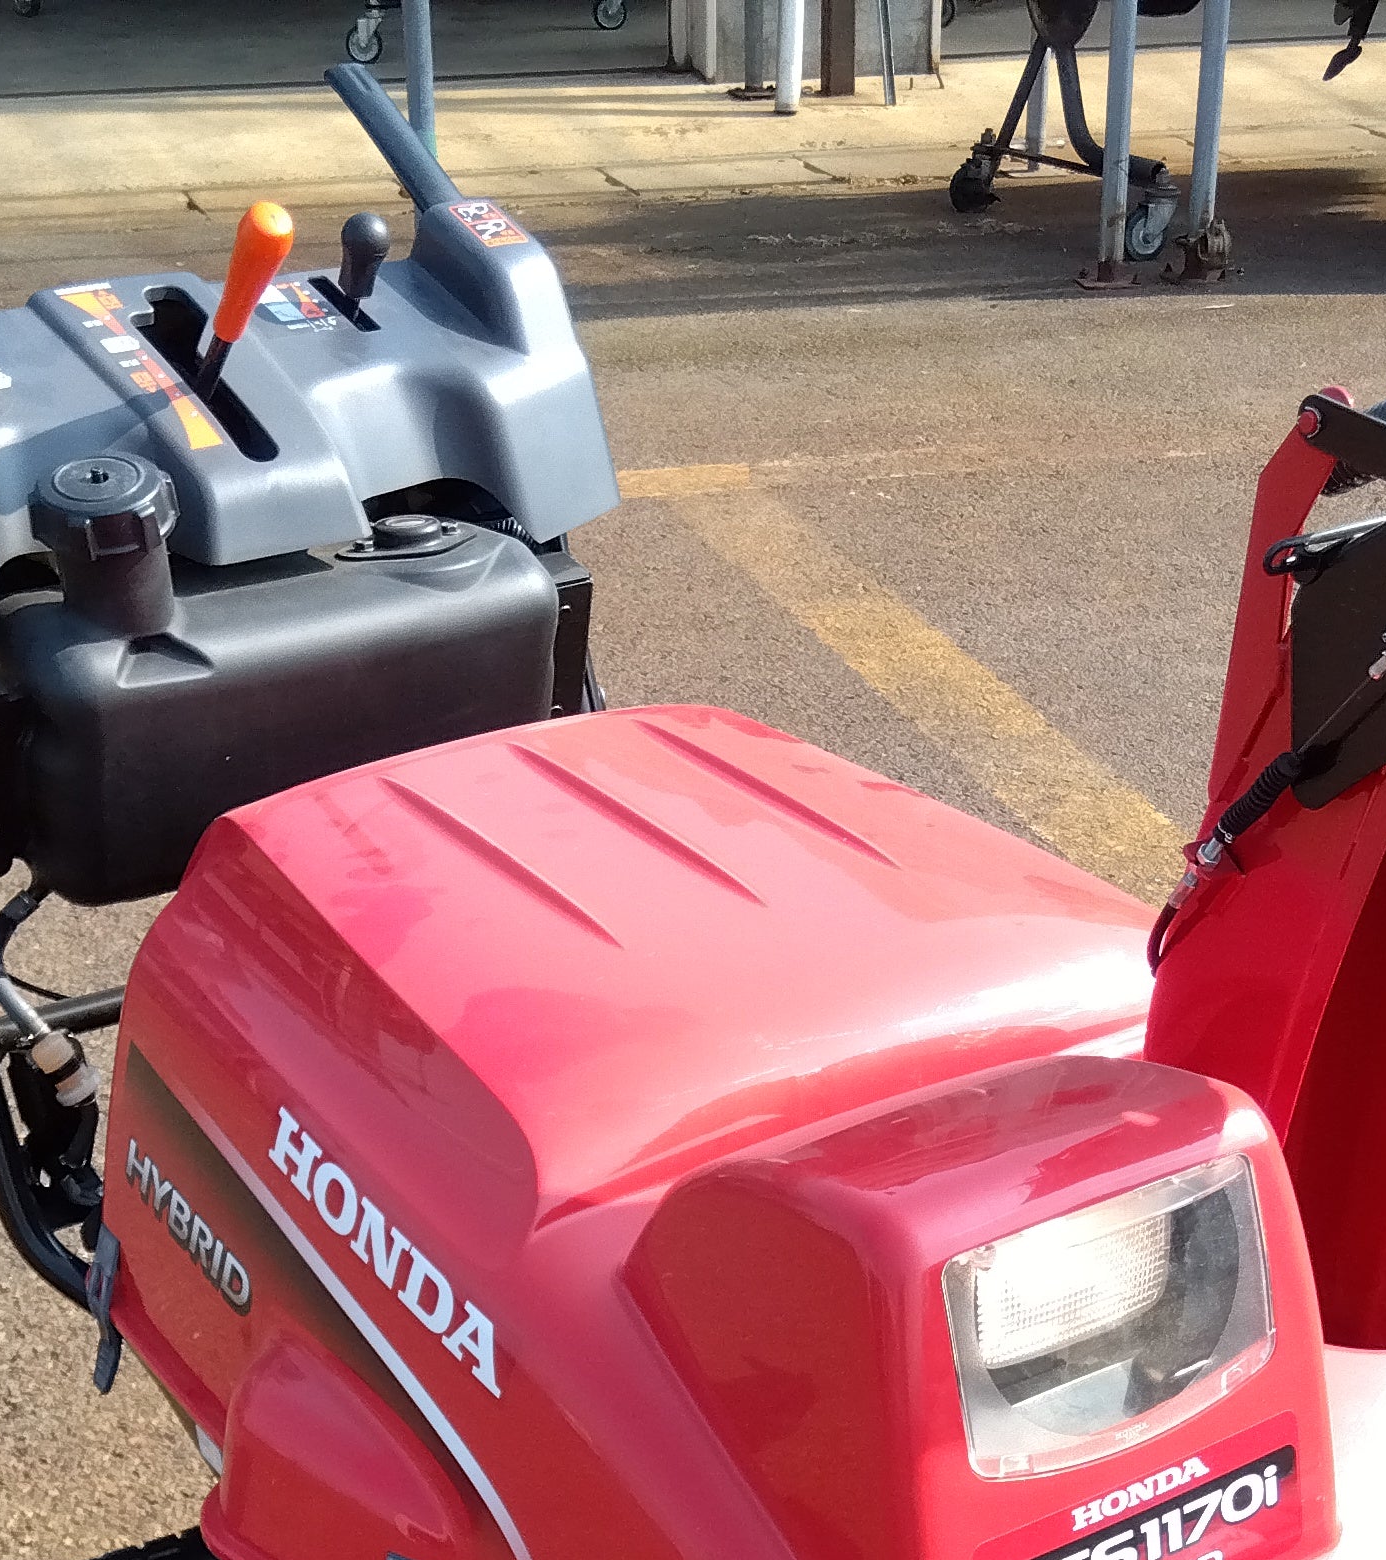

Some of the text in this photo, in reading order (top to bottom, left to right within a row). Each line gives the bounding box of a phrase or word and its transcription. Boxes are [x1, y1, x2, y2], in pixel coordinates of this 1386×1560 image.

[126, 1138, 251, 1313] HYBRID
[268, 1106, 501, 1399] HONDA
[1071, 1456, 1210, 1532] HONDA
